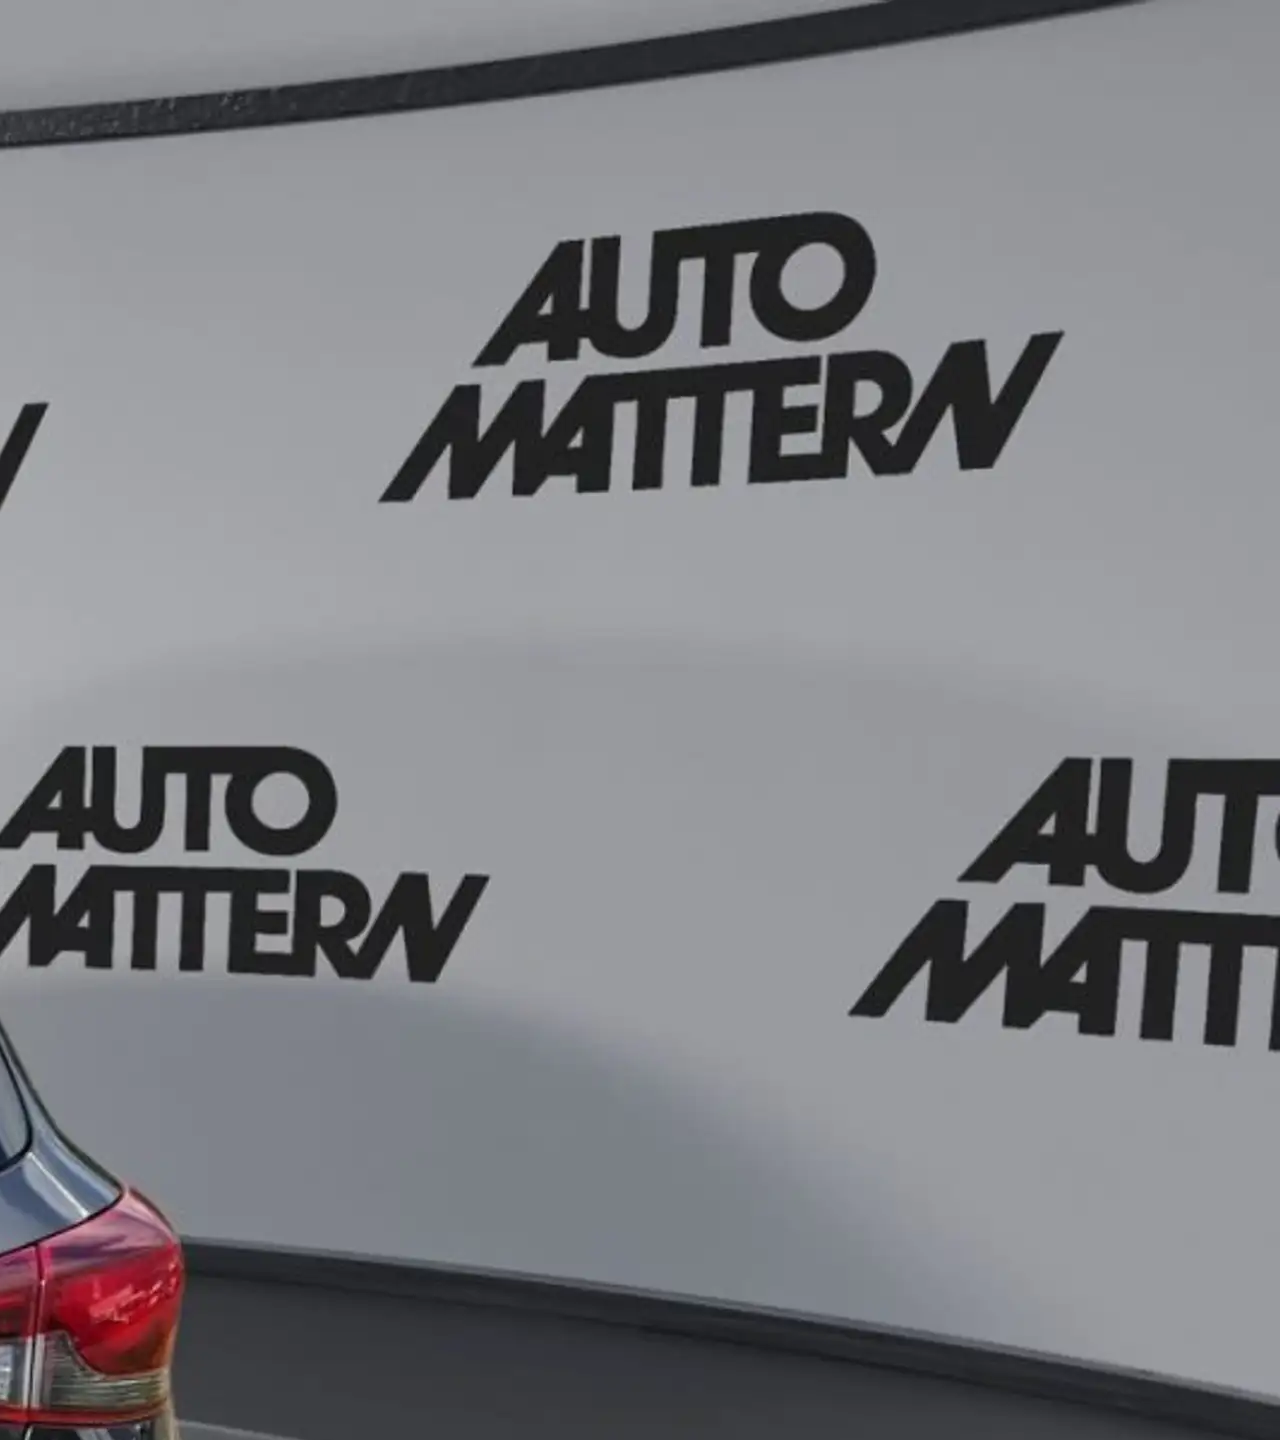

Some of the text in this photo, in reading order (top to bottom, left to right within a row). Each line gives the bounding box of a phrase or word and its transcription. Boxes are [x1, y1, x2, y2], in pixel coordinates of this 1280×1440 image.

[473, 212, 876, 367] AUTO
[379, 331, 1064, 502] MATTERN
[958, 757, 1280, 894] AUT
[849, 900, 1280, 1051] MATT
